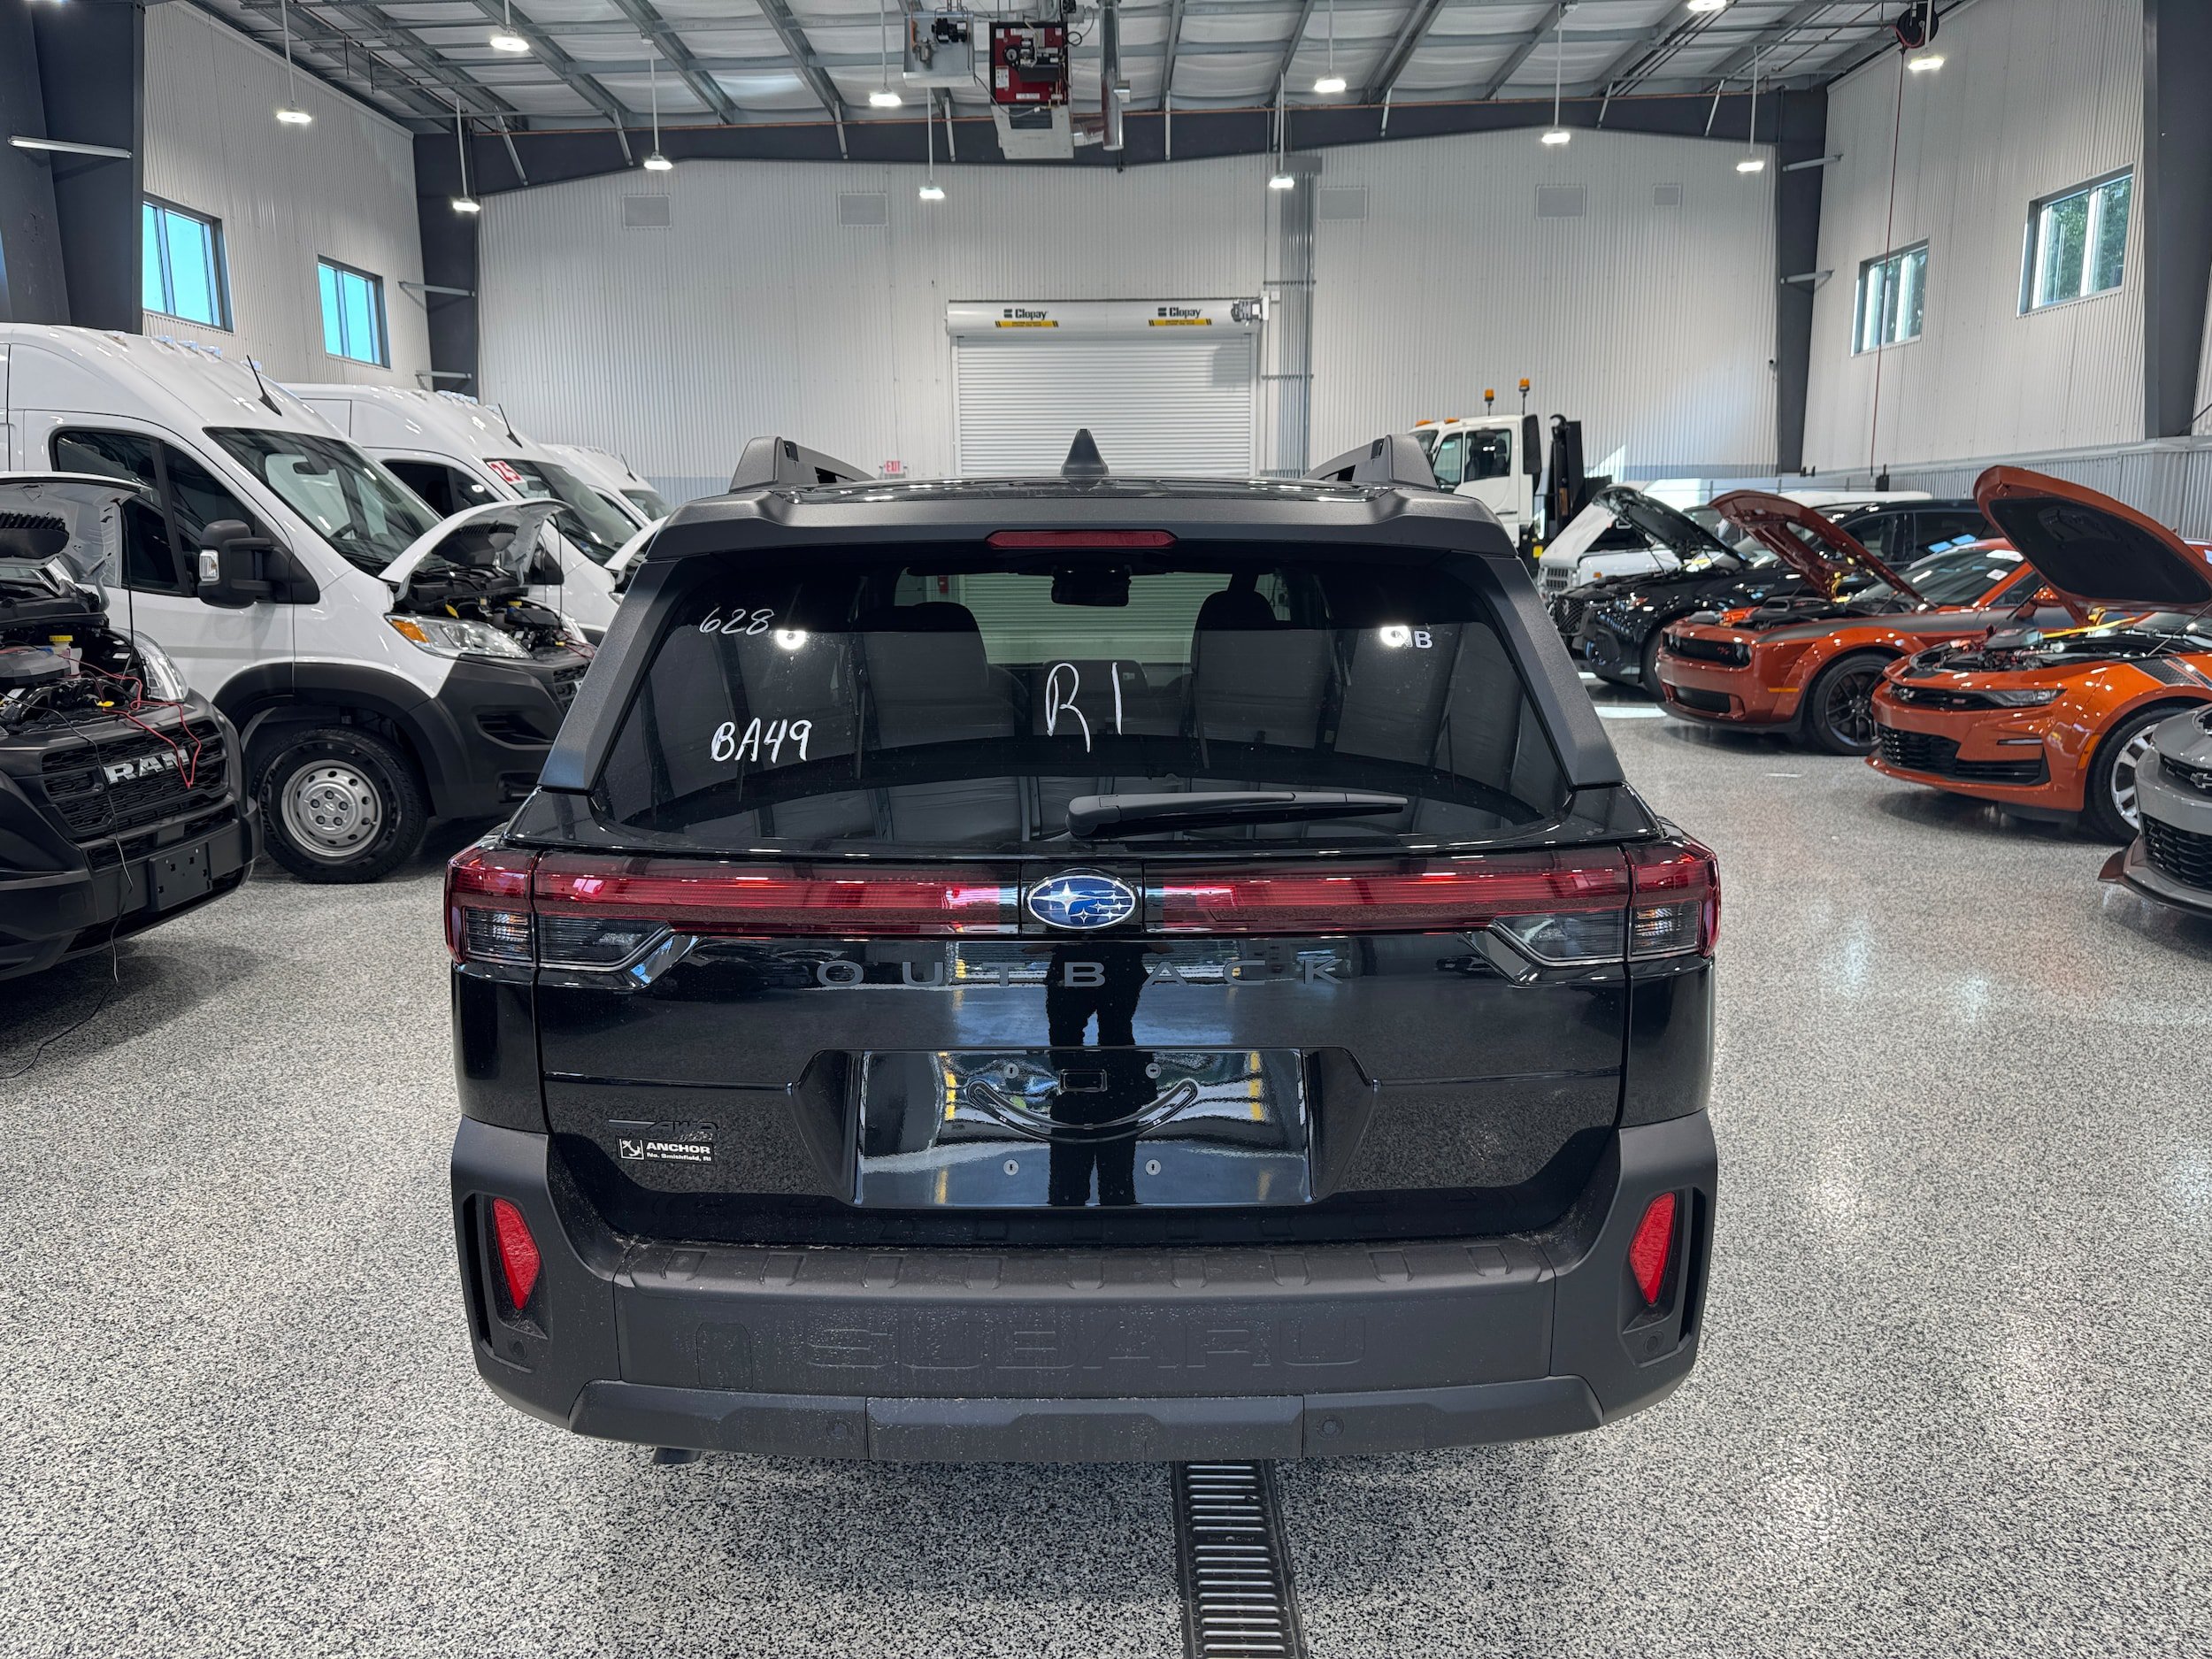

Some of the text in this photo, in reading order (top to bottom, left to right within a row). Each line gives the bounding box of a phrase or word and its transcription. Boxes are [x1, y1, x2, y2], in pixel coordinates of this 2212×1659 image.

[1015, 309, 1047, 320] Clopay
[1170, 307, 1202, 319] Clopay
[490, 461, 522, 482] 25
[886, 461, 901, 472] EXIT
[699, 606, 775, 635] 628
[710, 717, 812, 764] BA49
[103, 748, 190, 785] RAM
[816, 957, 1344, 988] OUTBACK
[646, 1141, 711, 1155] ANCHOR
[806, 1315, 1366, 1371] SUBARU
